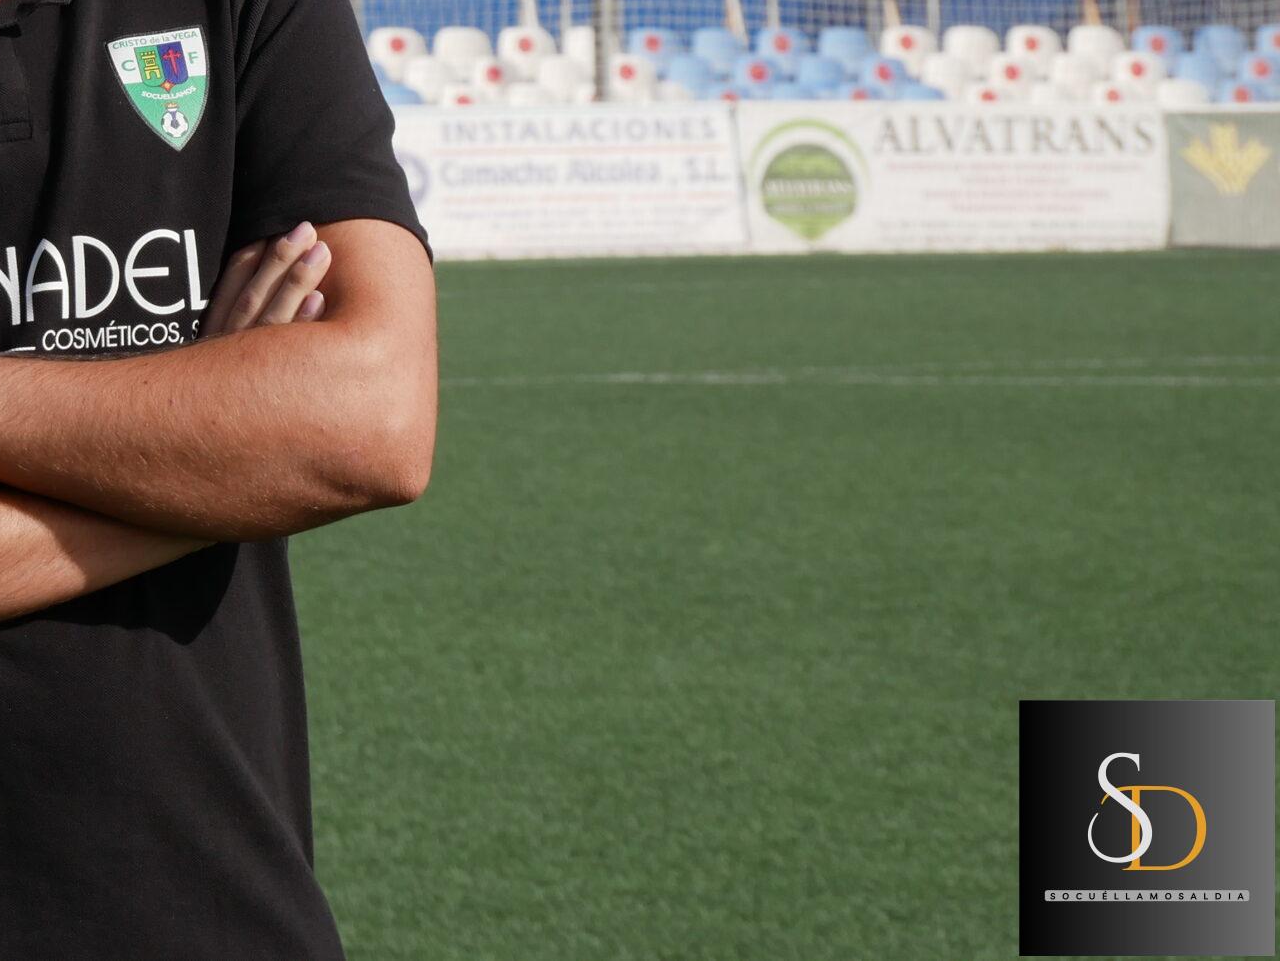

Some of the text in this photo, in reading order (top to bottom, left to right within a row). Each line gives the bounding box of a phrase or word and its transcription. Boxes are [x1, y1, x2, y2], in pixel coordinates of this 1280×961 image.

[112, 39, 147, 50] CRISTO
[150, 37, 160, 45] de
[170, 31, 198, 41] VEGA
[121, 51, 199, 72] C F
[441, 116, 718, 145] INSTALACIONES
[873, 113, 1156, 156] ALVATRANS
[42, 320, 184, 352] COSMÉTICOS,
